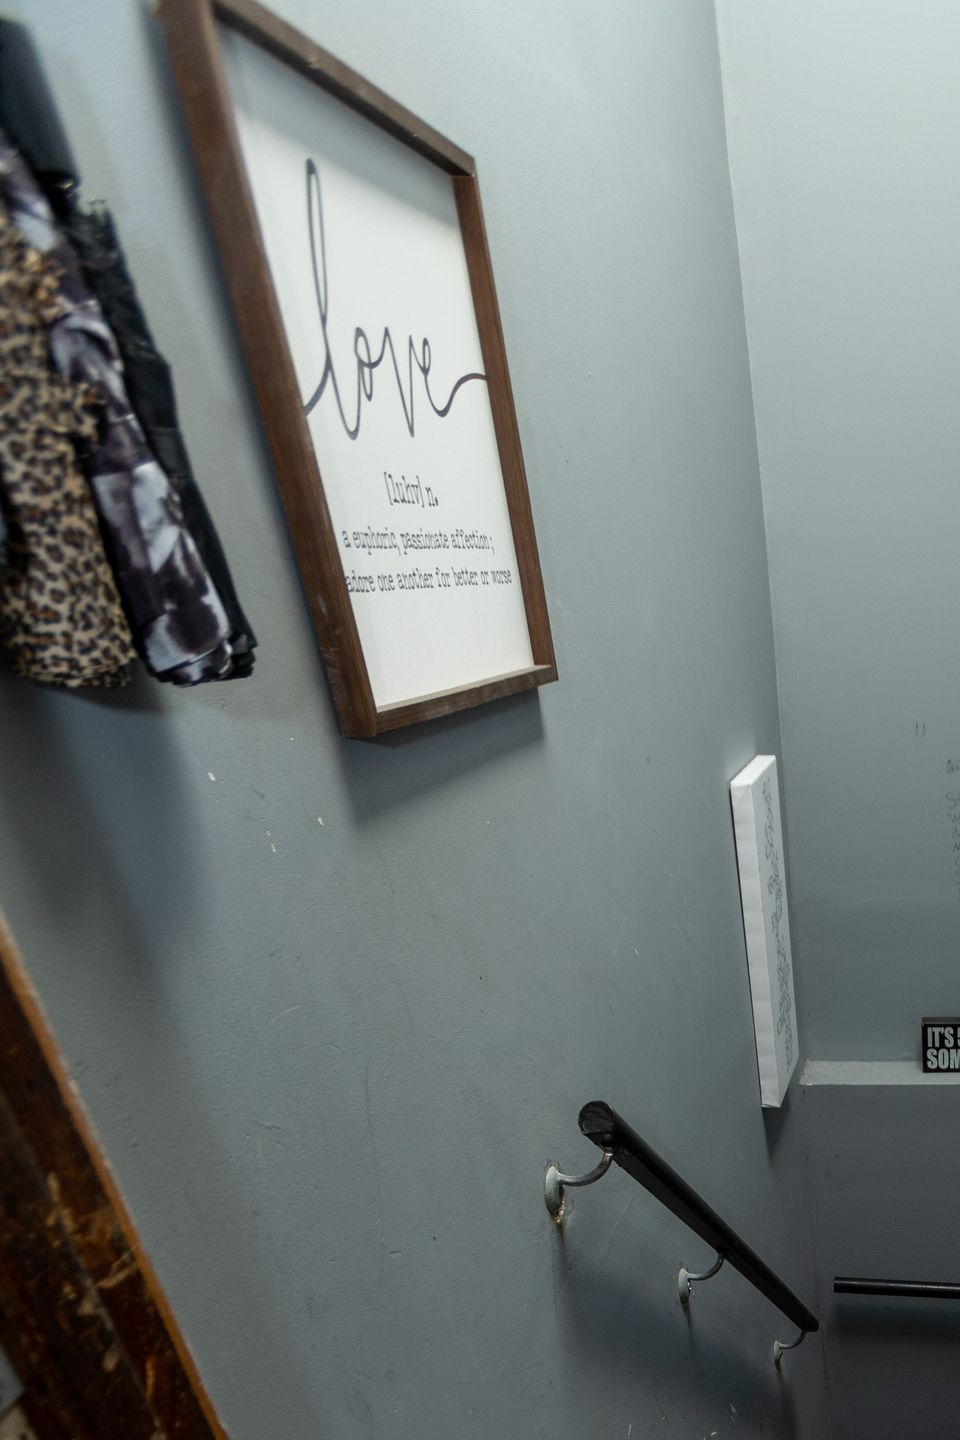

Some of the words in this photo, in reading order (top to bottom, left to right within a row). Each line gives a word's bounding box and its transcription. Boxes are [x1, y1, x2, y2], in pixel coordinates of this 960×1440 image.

[303, 157, 489, 441] love
[342, 530, 351, 548] a
[352, 526, 401, 556] euphoric,
[399, 528, 449, 555] passionate
[450, 529, 495, 556] affection;
[377, 574, 394, 592] one
[397, 568, 434, 590] another
[435, 566, 451, 588] for
[451, 566, 478, 587] better
[480, 573, 489, 585] or
[491, 568, 513, 584] worse
